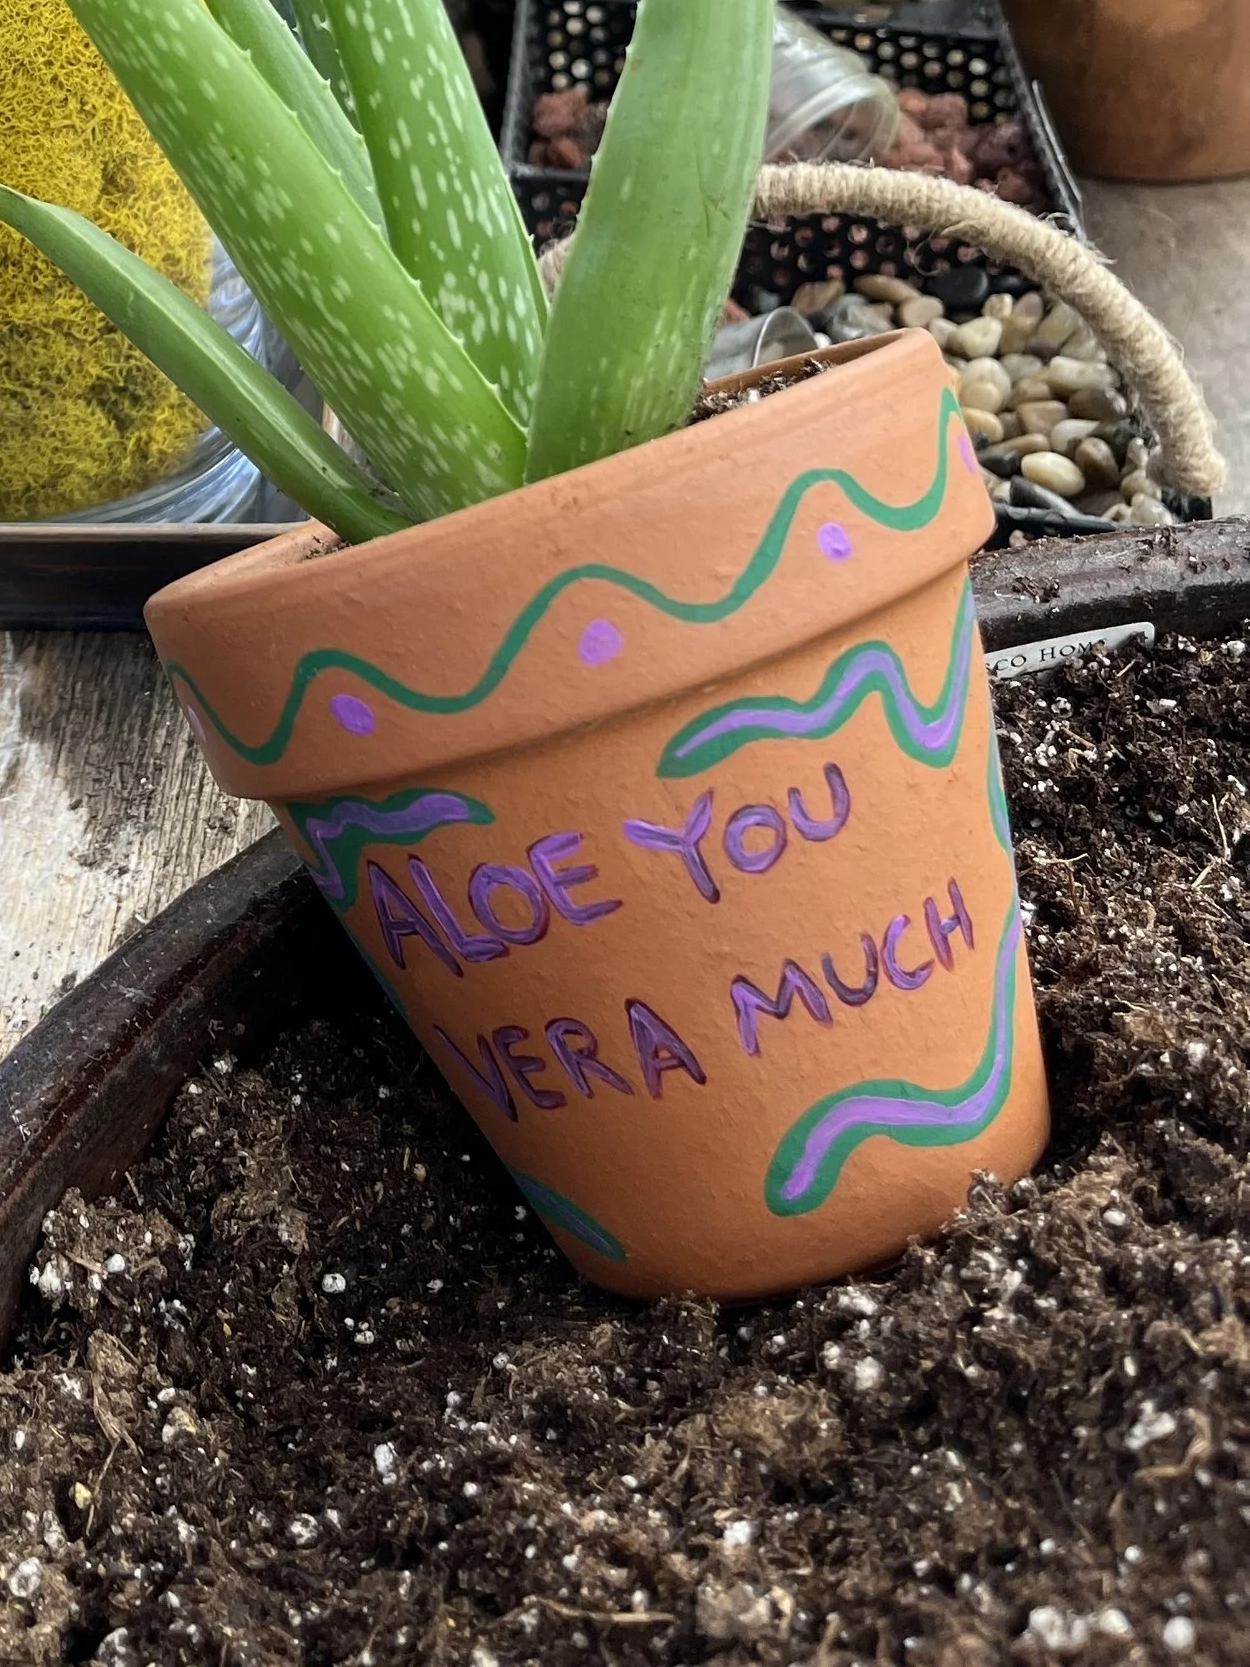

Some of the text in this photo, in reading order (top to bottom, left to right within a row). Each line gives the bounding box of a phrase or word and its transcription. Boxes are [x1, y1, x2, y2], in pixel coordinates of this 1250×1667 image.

[1039, 638, 1108, 663] HOM
[367, 762, 850, 977] ALOE YOU
[434, 877, 975, 1122] VERA MUCH
